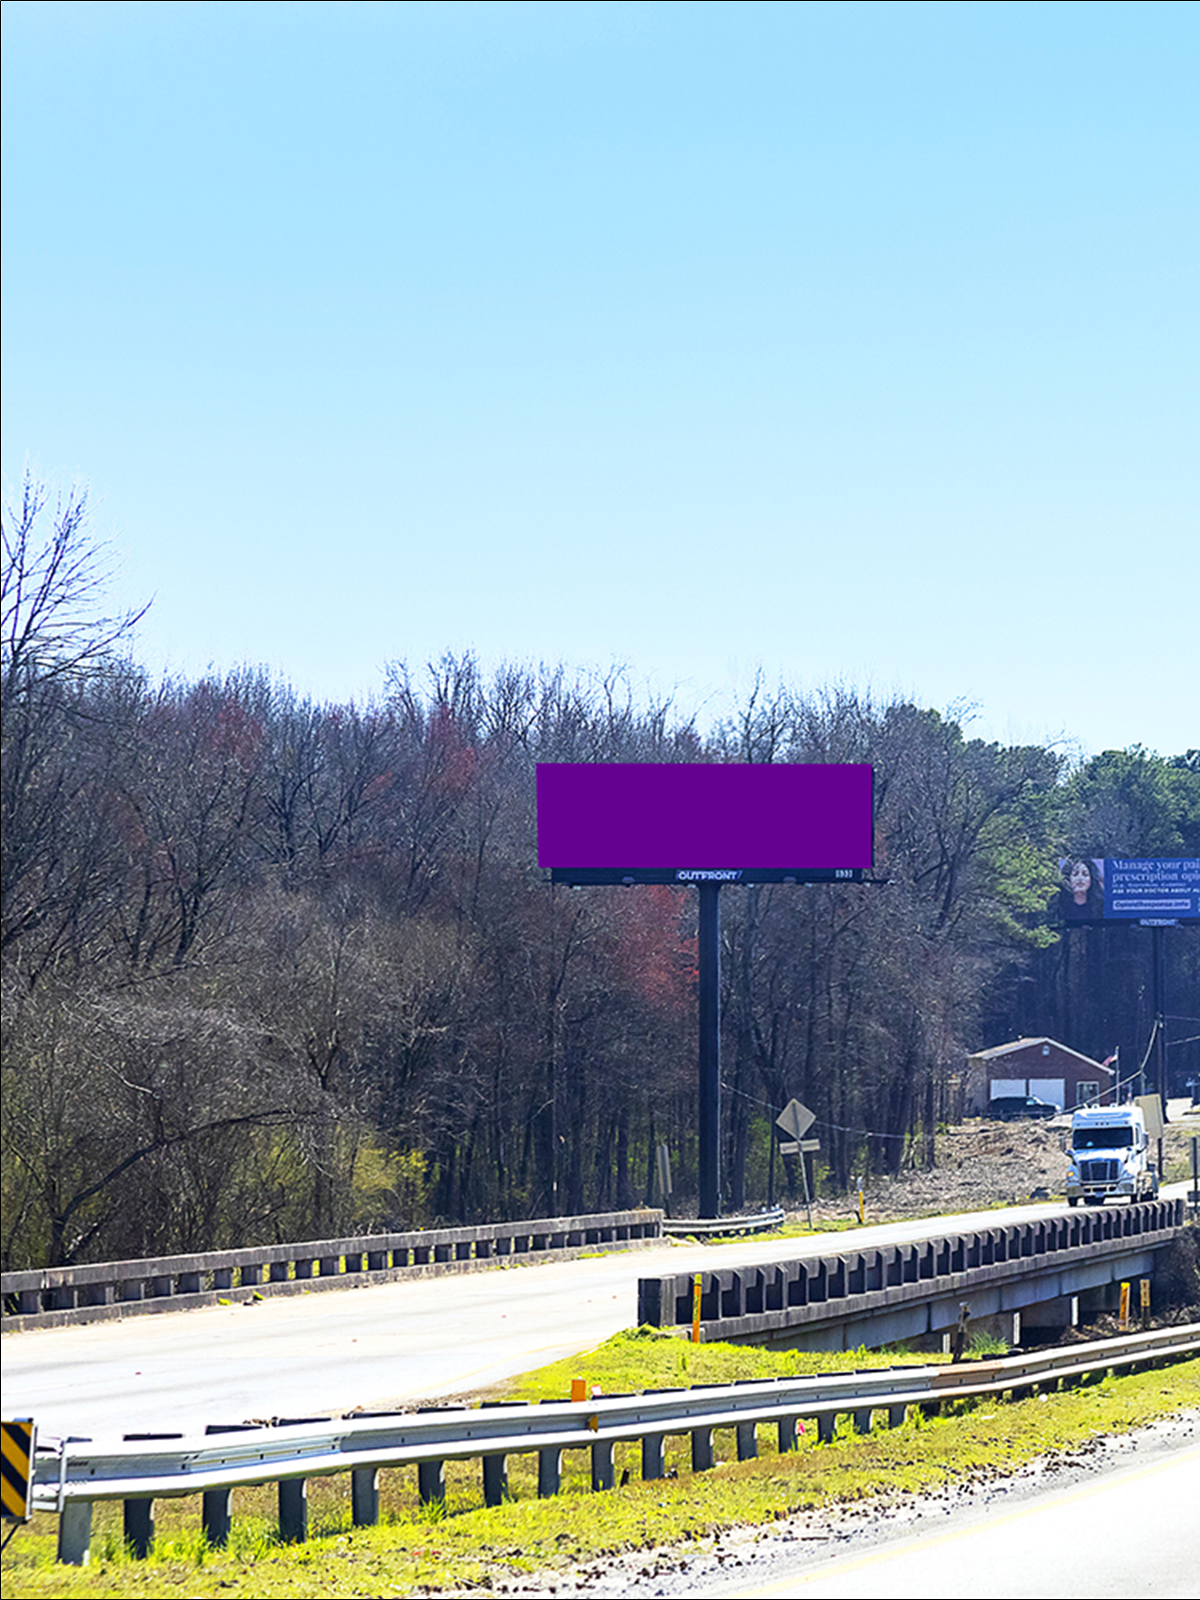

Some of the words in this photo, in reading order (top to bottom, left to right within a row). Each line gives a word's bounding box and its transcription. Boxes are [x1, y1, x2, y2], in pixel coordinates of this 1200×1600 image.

[1112, 860, 1154, 873] Manage
[1156, 861, 1181, 873] your
[678, 870, 738, 880] OUTFRONT
[1112, 870, 1178, 883] prescription
